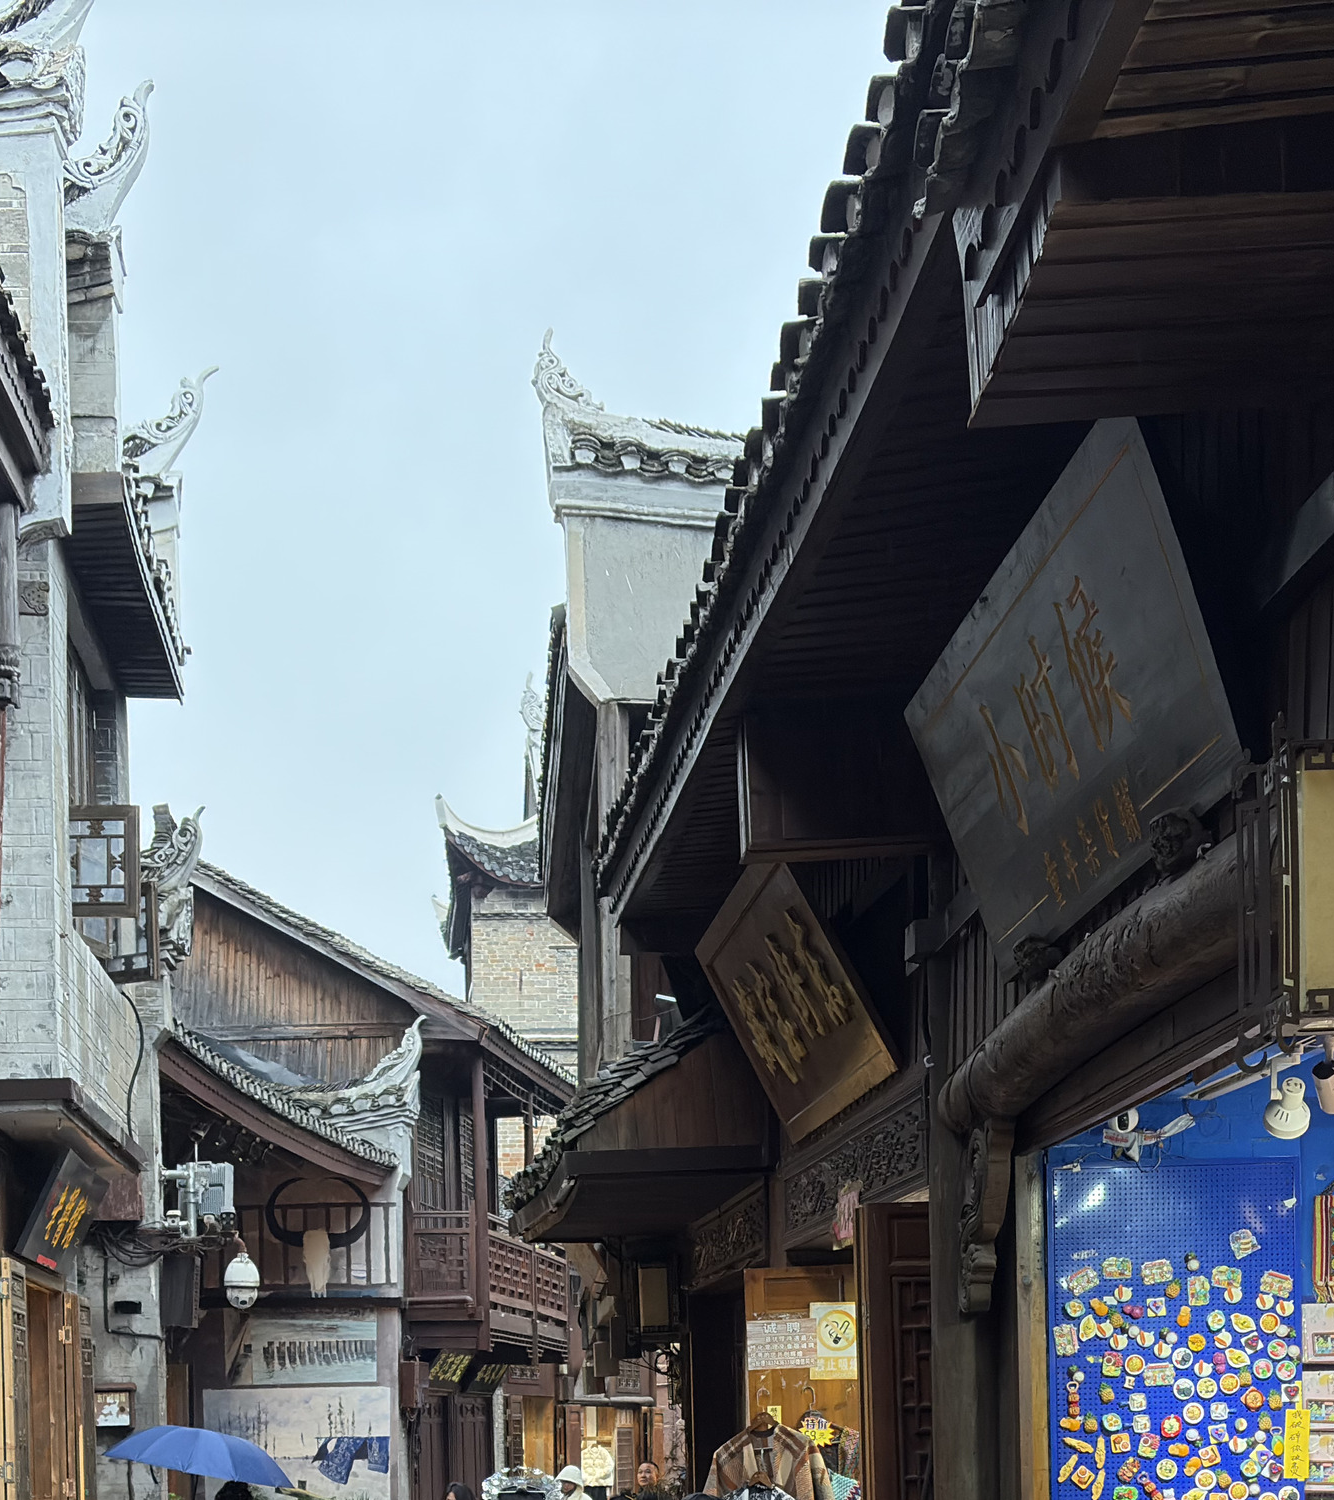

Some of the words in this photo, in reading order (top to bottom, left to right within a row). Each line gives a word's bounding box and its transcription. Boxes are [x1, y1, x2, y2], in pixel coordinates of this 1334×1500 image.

[978, 574, 1134, 836] 小时候
[805, 1419, 828, 1430] 特价
